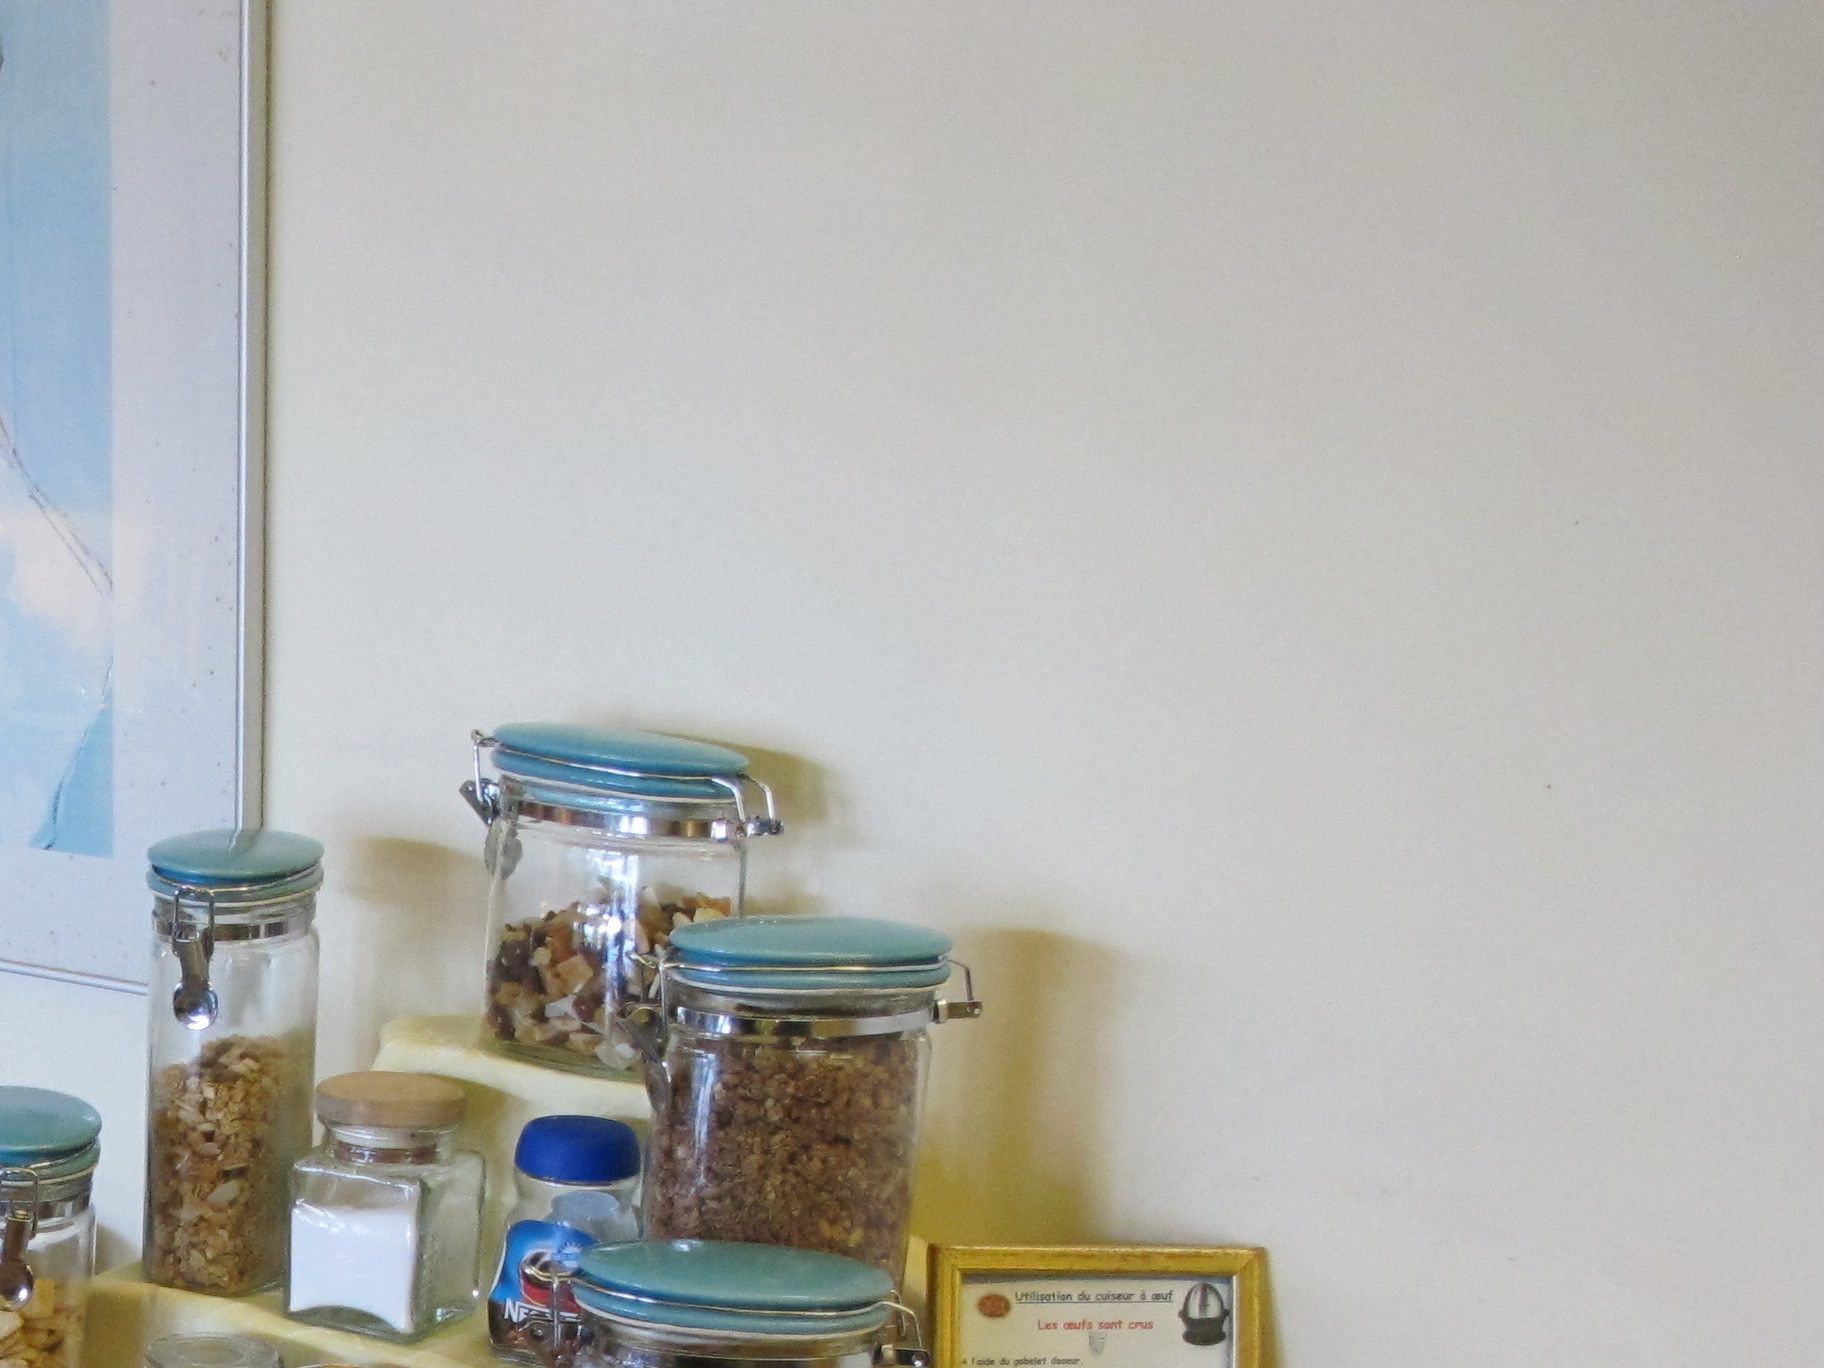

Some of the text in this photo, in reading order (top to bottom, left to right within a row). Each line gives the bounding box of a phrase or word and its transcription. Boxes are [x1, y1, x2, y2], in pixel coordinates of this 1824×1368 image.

[1015, 1290, 1073, 1302] Utilisation
[1077, 1290, 1090, 1302] du
[1095, 1290, 1133, 1302] cuiseur
[1151, 1290, 1173, 1302] œuf
[1037, 1318, 1154, 1330] Les œufs sont crus
